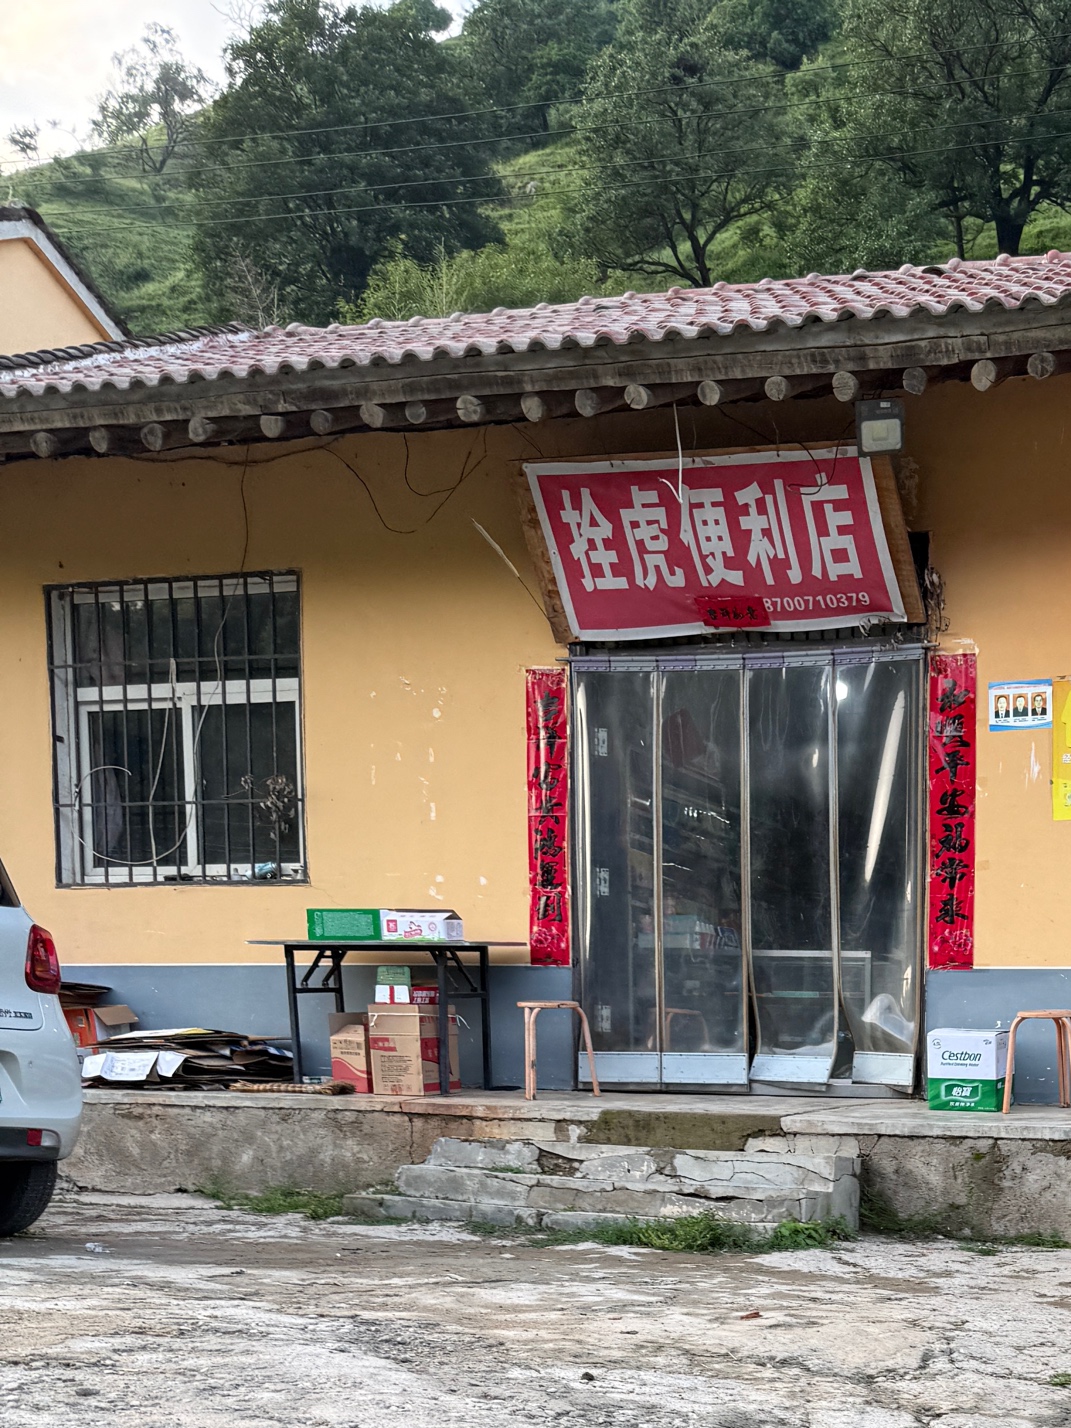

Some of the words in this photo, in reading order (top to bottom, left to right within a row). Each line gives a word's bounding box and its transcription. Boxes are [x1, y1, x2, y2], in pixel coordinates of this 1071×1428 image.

[560, 473, 864, 594] 拴虎便利店
[763, 591, 871, 612] 8700710379
